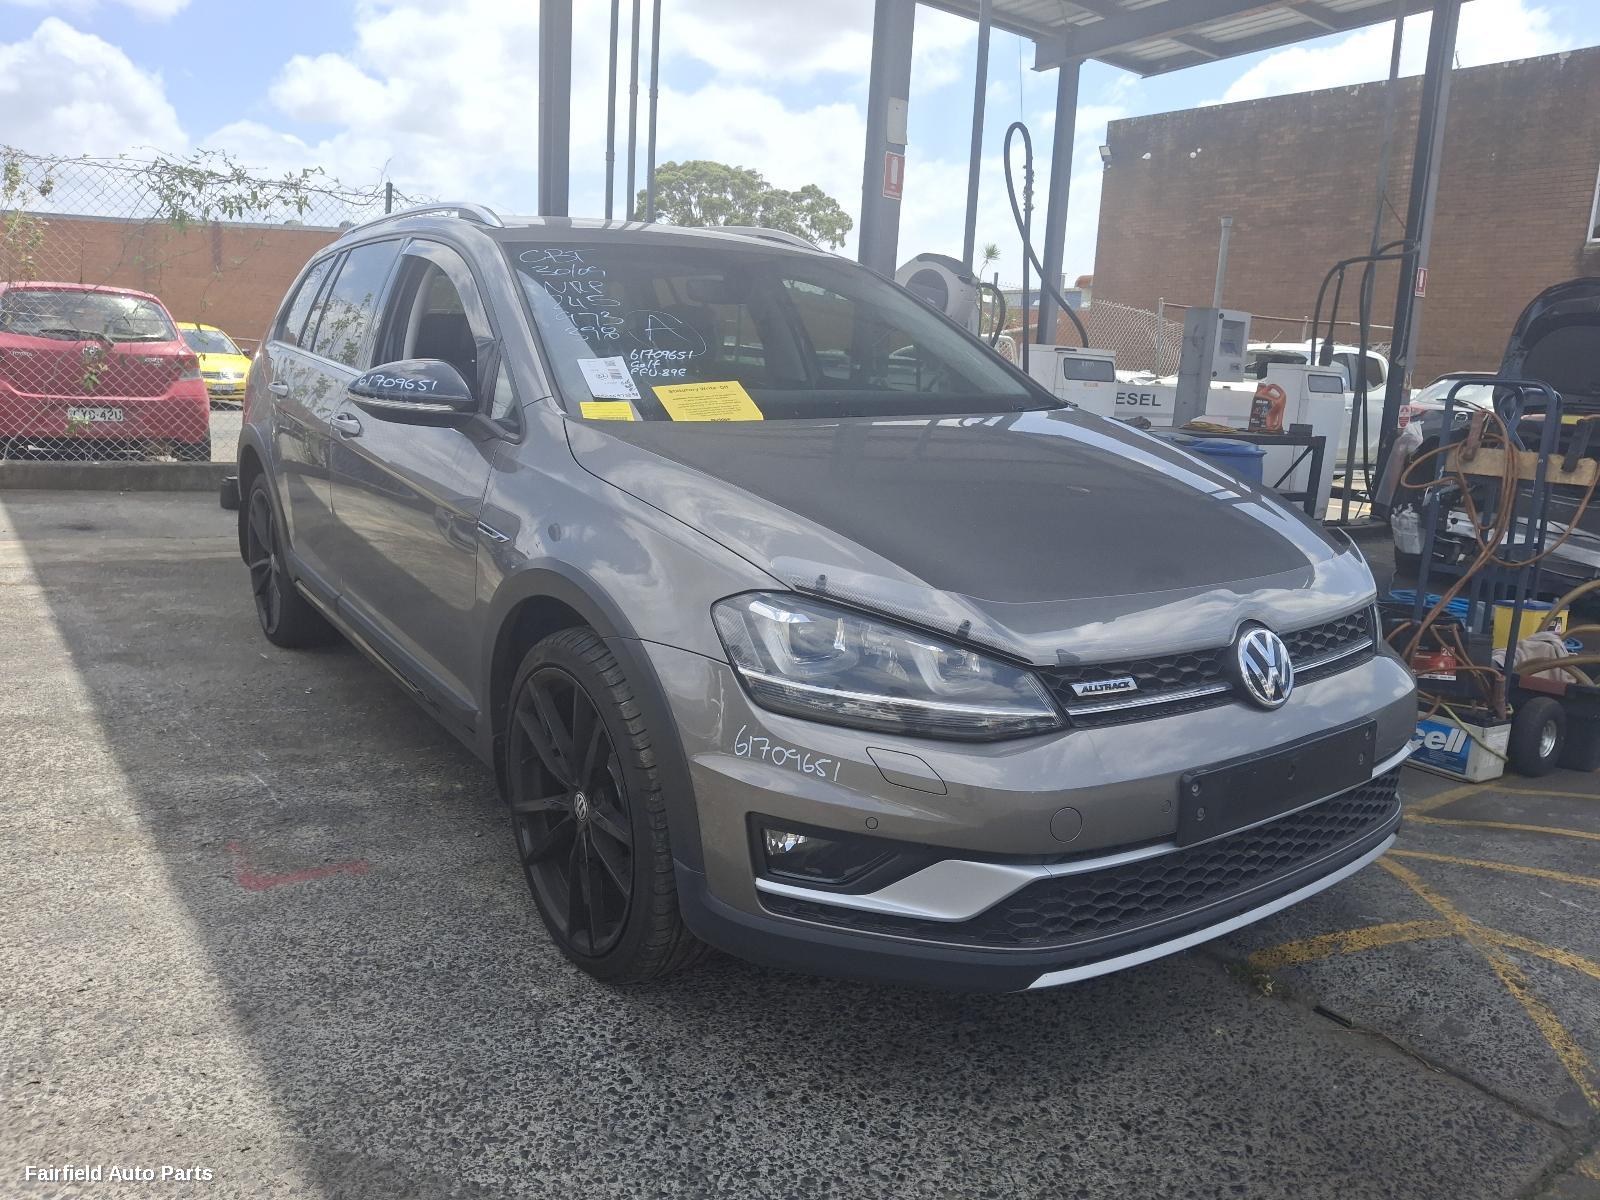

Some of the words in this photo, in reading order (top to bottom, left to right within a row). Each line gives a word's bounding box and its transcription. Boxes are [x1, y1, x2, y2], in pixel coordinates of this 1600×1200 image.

[630, 348, 694, 360] 61709651
[630, 359, 661, 369] Golf
[358, 374, 438, 391] 61709651
[1081, 681, 1131, 694] ALLTRACK
[734, 724, 841, 782] 61709651
